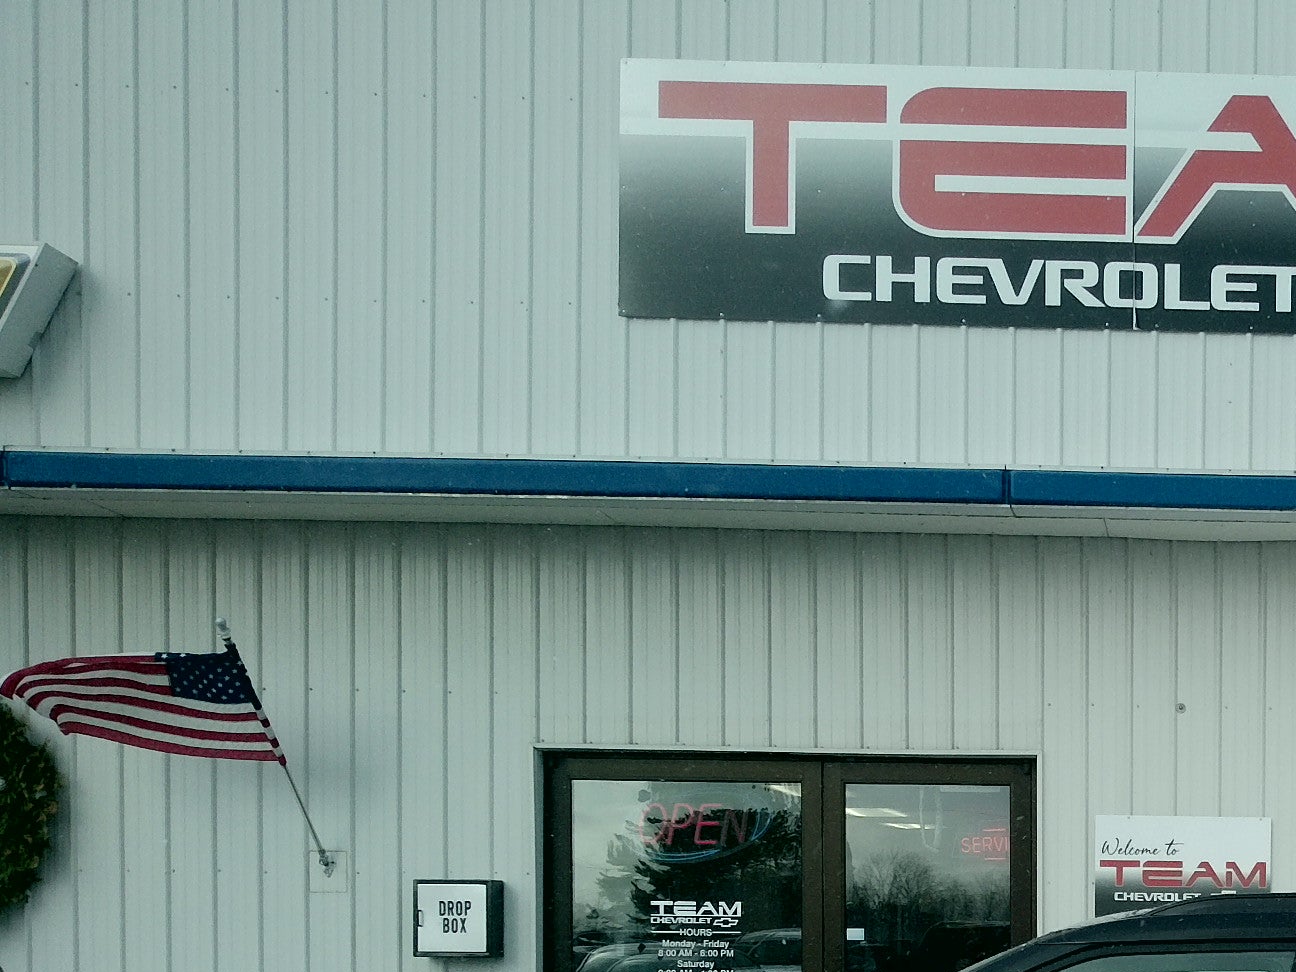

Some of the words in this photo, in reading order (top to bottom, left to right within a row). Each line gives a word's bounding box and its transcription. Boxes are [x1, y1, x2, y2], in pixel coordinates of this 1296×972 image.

[638, 803, 749, 847] OPEN
[1101, 837, 1161, 856] Welcome
[1164, 838, 1184, 856] to
[1099, 860, 1268, 888] TEAM
[438, 900, 472, 917] DROP
[650, 900, 742, 917] TEAM
[442, 917, 467, 934] BOX
[650, 916, 712, 924] CHEVROLET
[679, 928, 713, 937] HOURS
[661, 939, 697, 950] Monday
[703, 939, 730, 950] Friday
[657, 949, 677, 958] 8:00
[678, 949, 693, 957] AM
[700, 949, 719, 958] 6:00
[720, 949, 734, 958] PM
[676, 959, 715, 970] Saturday
